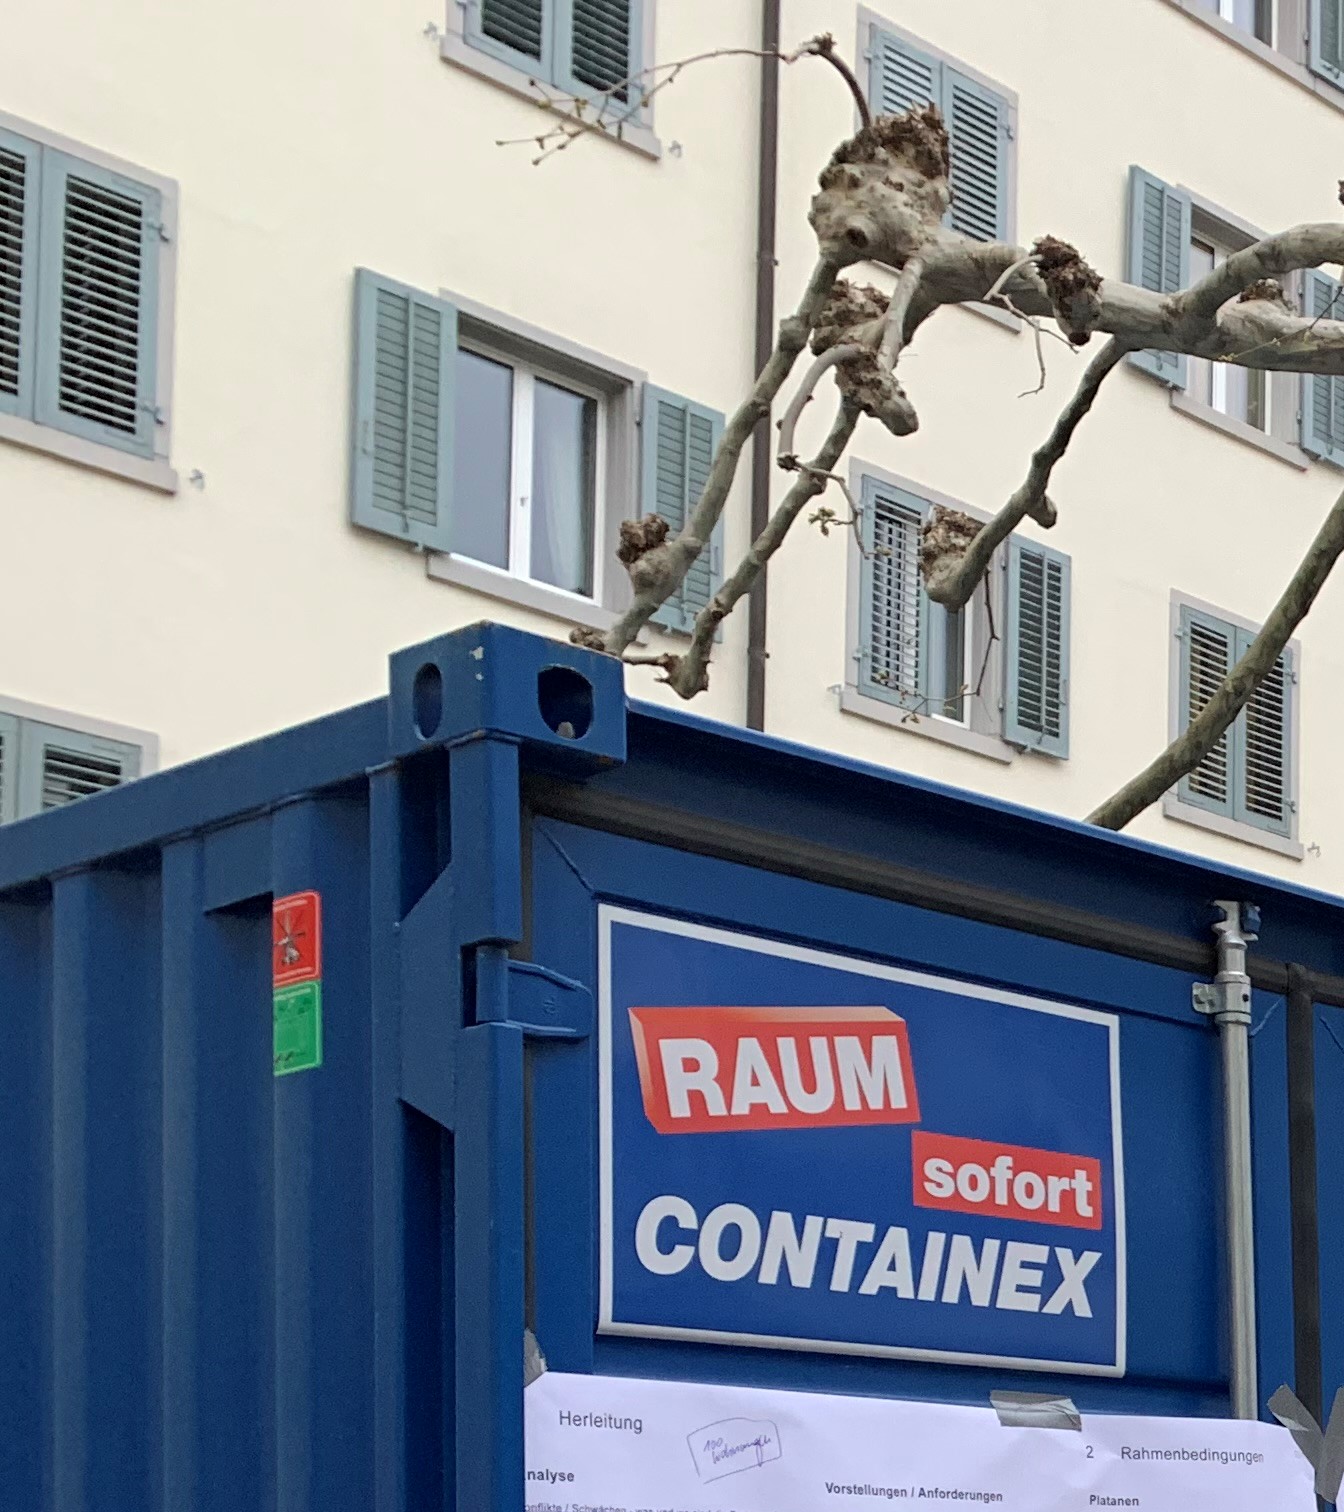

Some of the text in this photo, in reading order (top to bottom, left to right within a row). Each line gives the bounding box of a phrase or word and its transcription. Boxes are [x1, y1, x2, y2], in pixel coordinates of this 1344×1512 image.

[658, 1035, 908, 1119] RAUM
[922, 1155, 1094, 1218] sofort
[635, 1195, 1102, 1318] CONTAINEX
[559, 1410, 643, 1435] Herleitung
[1086, 1445, 1265, 1465] 2 Rahmenbedingungen
[525, 1468, 575, 1485] nalyse
[824, 1482, 908, 1500] Vorstellungen
[918, 1487, 1004, 1504] Anforderungen
[1089, 1494, 1140, 1508] Platanen
[525, 1502, 562, 1512] onflikte
